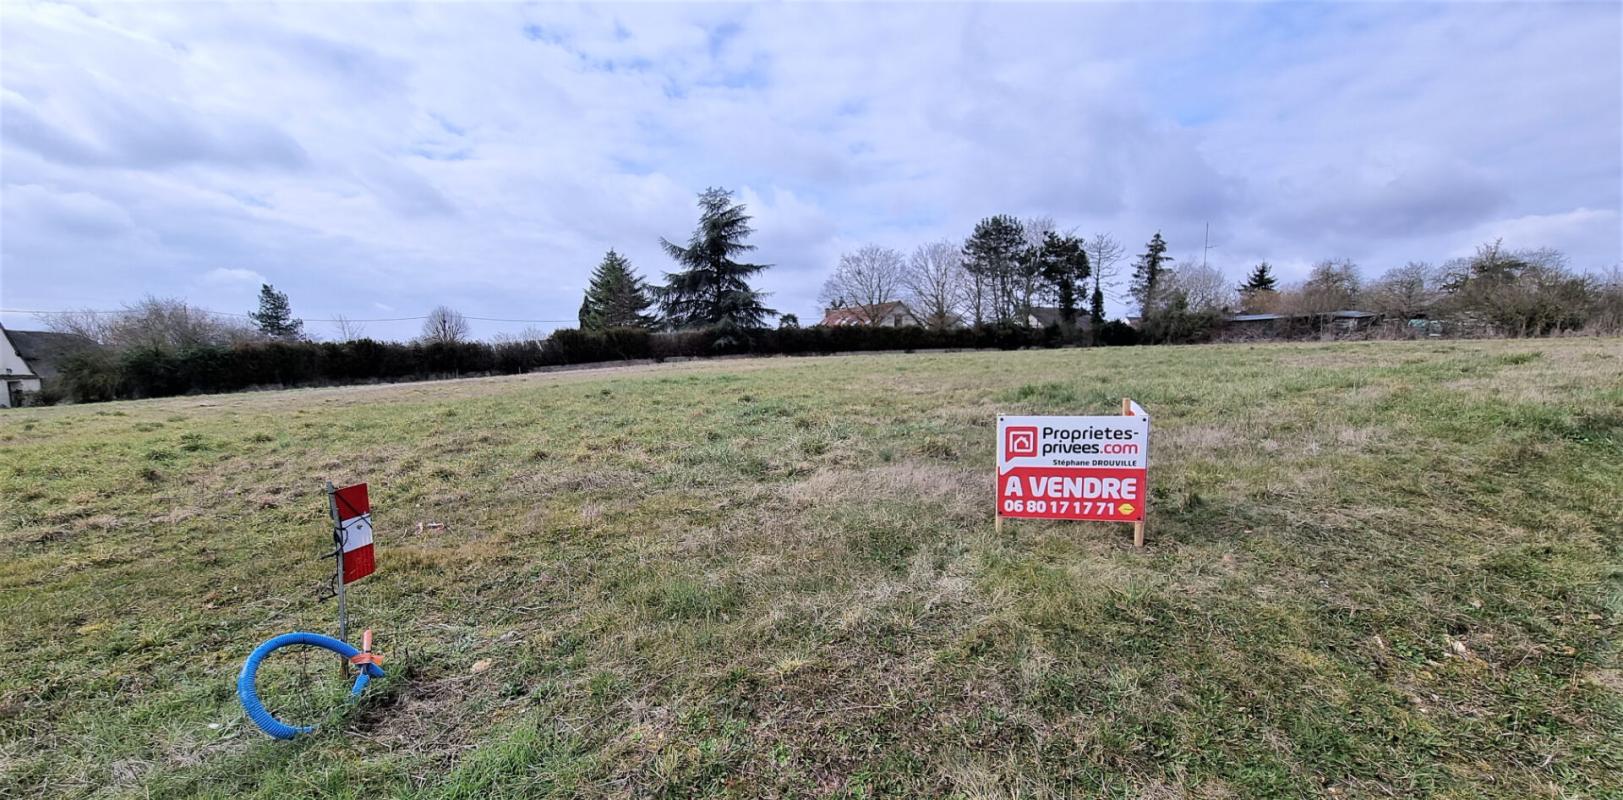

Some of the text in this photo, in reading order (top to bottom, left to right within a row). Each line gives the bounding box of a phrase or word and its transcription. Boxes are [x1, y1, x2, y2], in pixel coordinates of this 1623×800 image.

[1043, 426, 1139, 442] Proprietes-
[1043, 440, 1138, 456] privees.com
[1004, 476, 1137, 499] A VENDRE
[1004, 500, 1023, 512] 06
[1027, 500, 1046, 512] 80
[1050, 501, 1069, 513] 17
[1073, 502, 1092, 514] 17
[1096, 502, 1114, 515] 71
